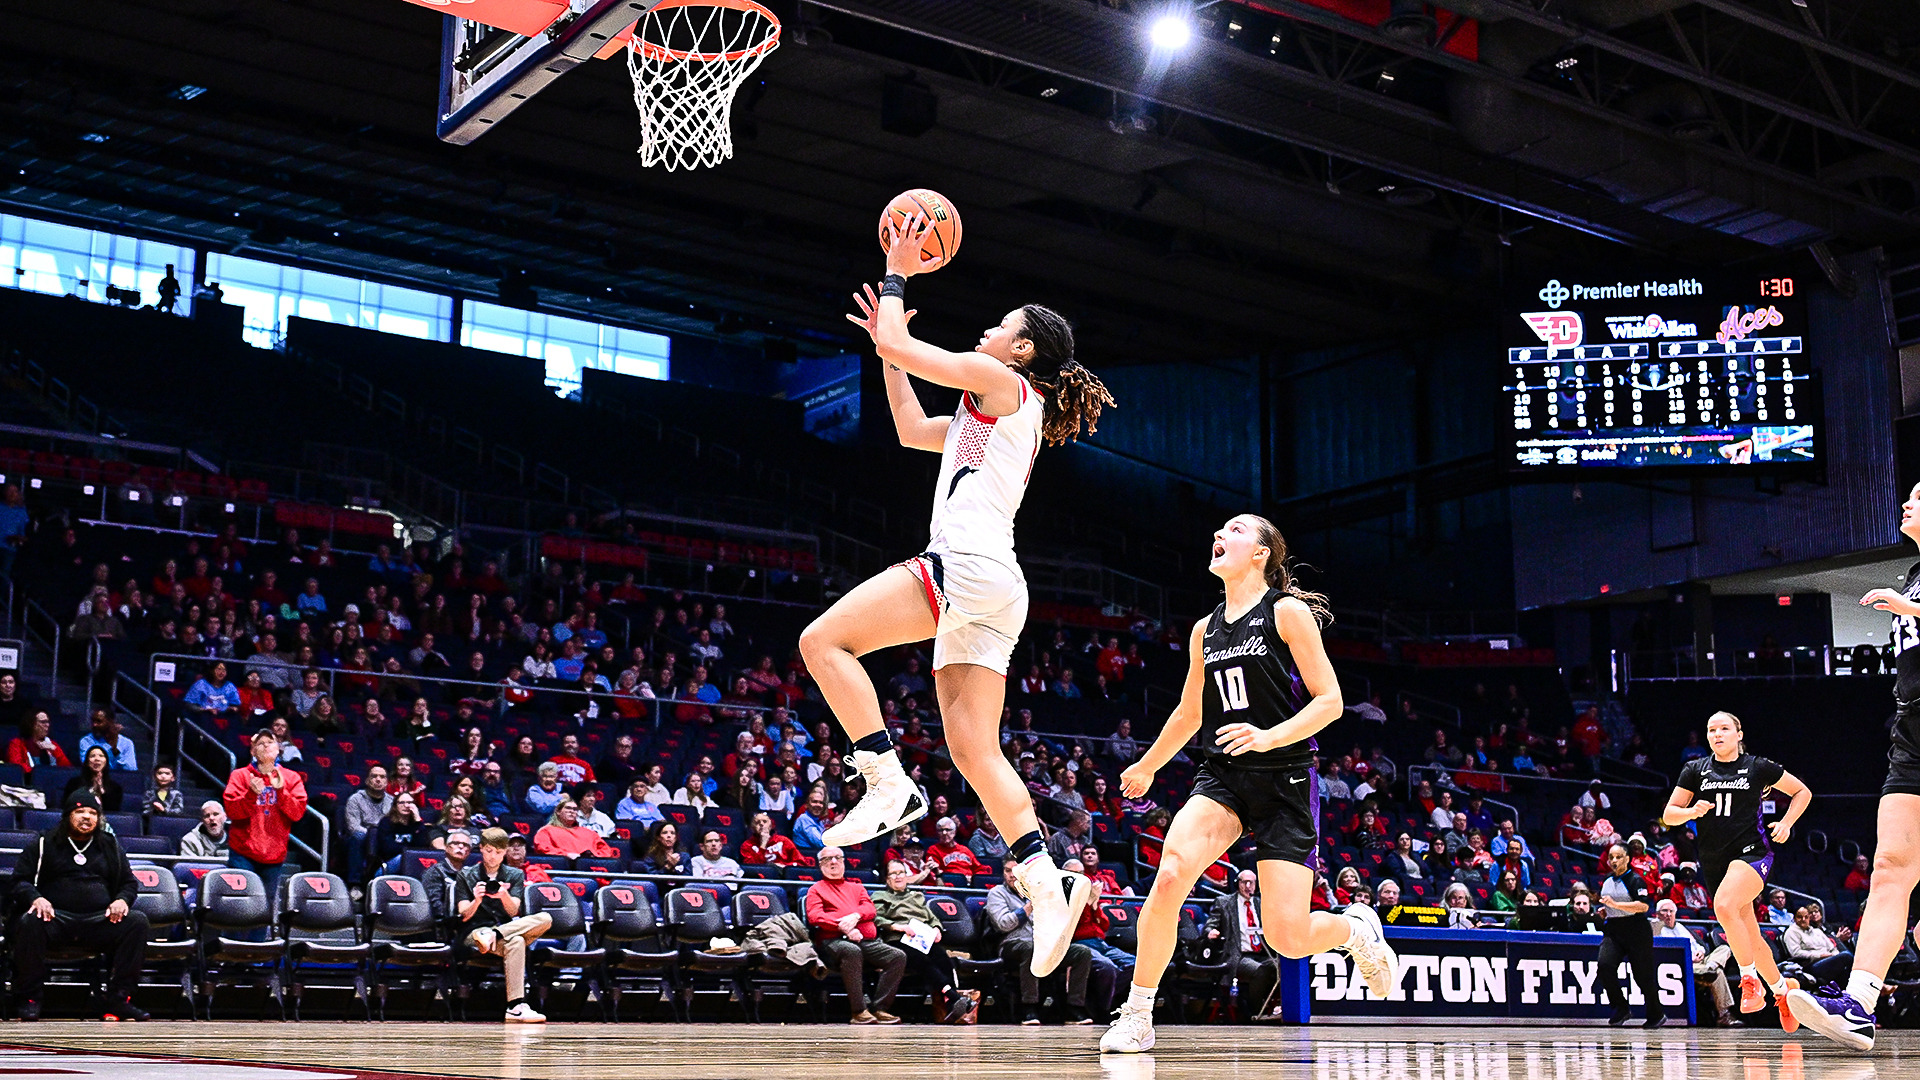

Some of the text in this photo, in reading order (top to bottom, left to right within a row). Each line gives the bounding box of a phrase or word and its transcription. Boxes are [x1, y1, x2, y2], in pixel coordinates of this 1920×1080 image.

[1573, 278, 1703, 300] Premier Health
[1760, 278, 1793, 297] 1:30
[1716, 305, 1784, 344] Aces
[1602, 346, 1613, 358] A
[1753, 340, 1765, 353] A
[1516, 363, 1640, 378] 1 10 0 1 0
[1728, 359, 1737, 370] 0
[1755, 358, 1765, 369] 0
[1782, 358, 1790, 368] 1
[1517, 381, 1526, 392] 4
[1547, 379, 1557, 389] 0
[1576, 378, 1583, 389] 1
[1604, 377, 1613, 387] 0
[1668, 374, 1684, 385] 10
[1729, 372, 1736, 383] 1
[1783, 370, 1793, 381] 0
[1514, 389, 1641, 405] 10 0 0 0 0
[1668, 383, 1793, 398] 11 0 0 0 0
[1548, 404, 1558, 415] 0
[1577, 403, 1584, 414] 1
[1604, 402, 1614, 413] 0
[1633, 401, 1642, 412] 0
[1697, 399, 1714, 410] 10
[1730, 398, 1737, 409] 1
[1757, 397, 1765, 408] 1
[1785, 396, 1792, 407] 1
[1549, 417, 1558, 428] 4
[1605, 415, 1613, 426] 1
[1633, 414, 1643, 425] 0
[1701, 411, 1710, 422] 0
[1730, 410, 1740, 421] 0
[1758, 409, 1767, 420] 0
[1786, 408, 1795, 419] 0
[1203, 636, 1267, 666] Evansville
[1213, 666, 1250, 713] 10
[1700, 777, 1750, 792] Evansville
[1715, 793, 1732, 816] 11
[1516, 958, 1684, 1006] FLYS
